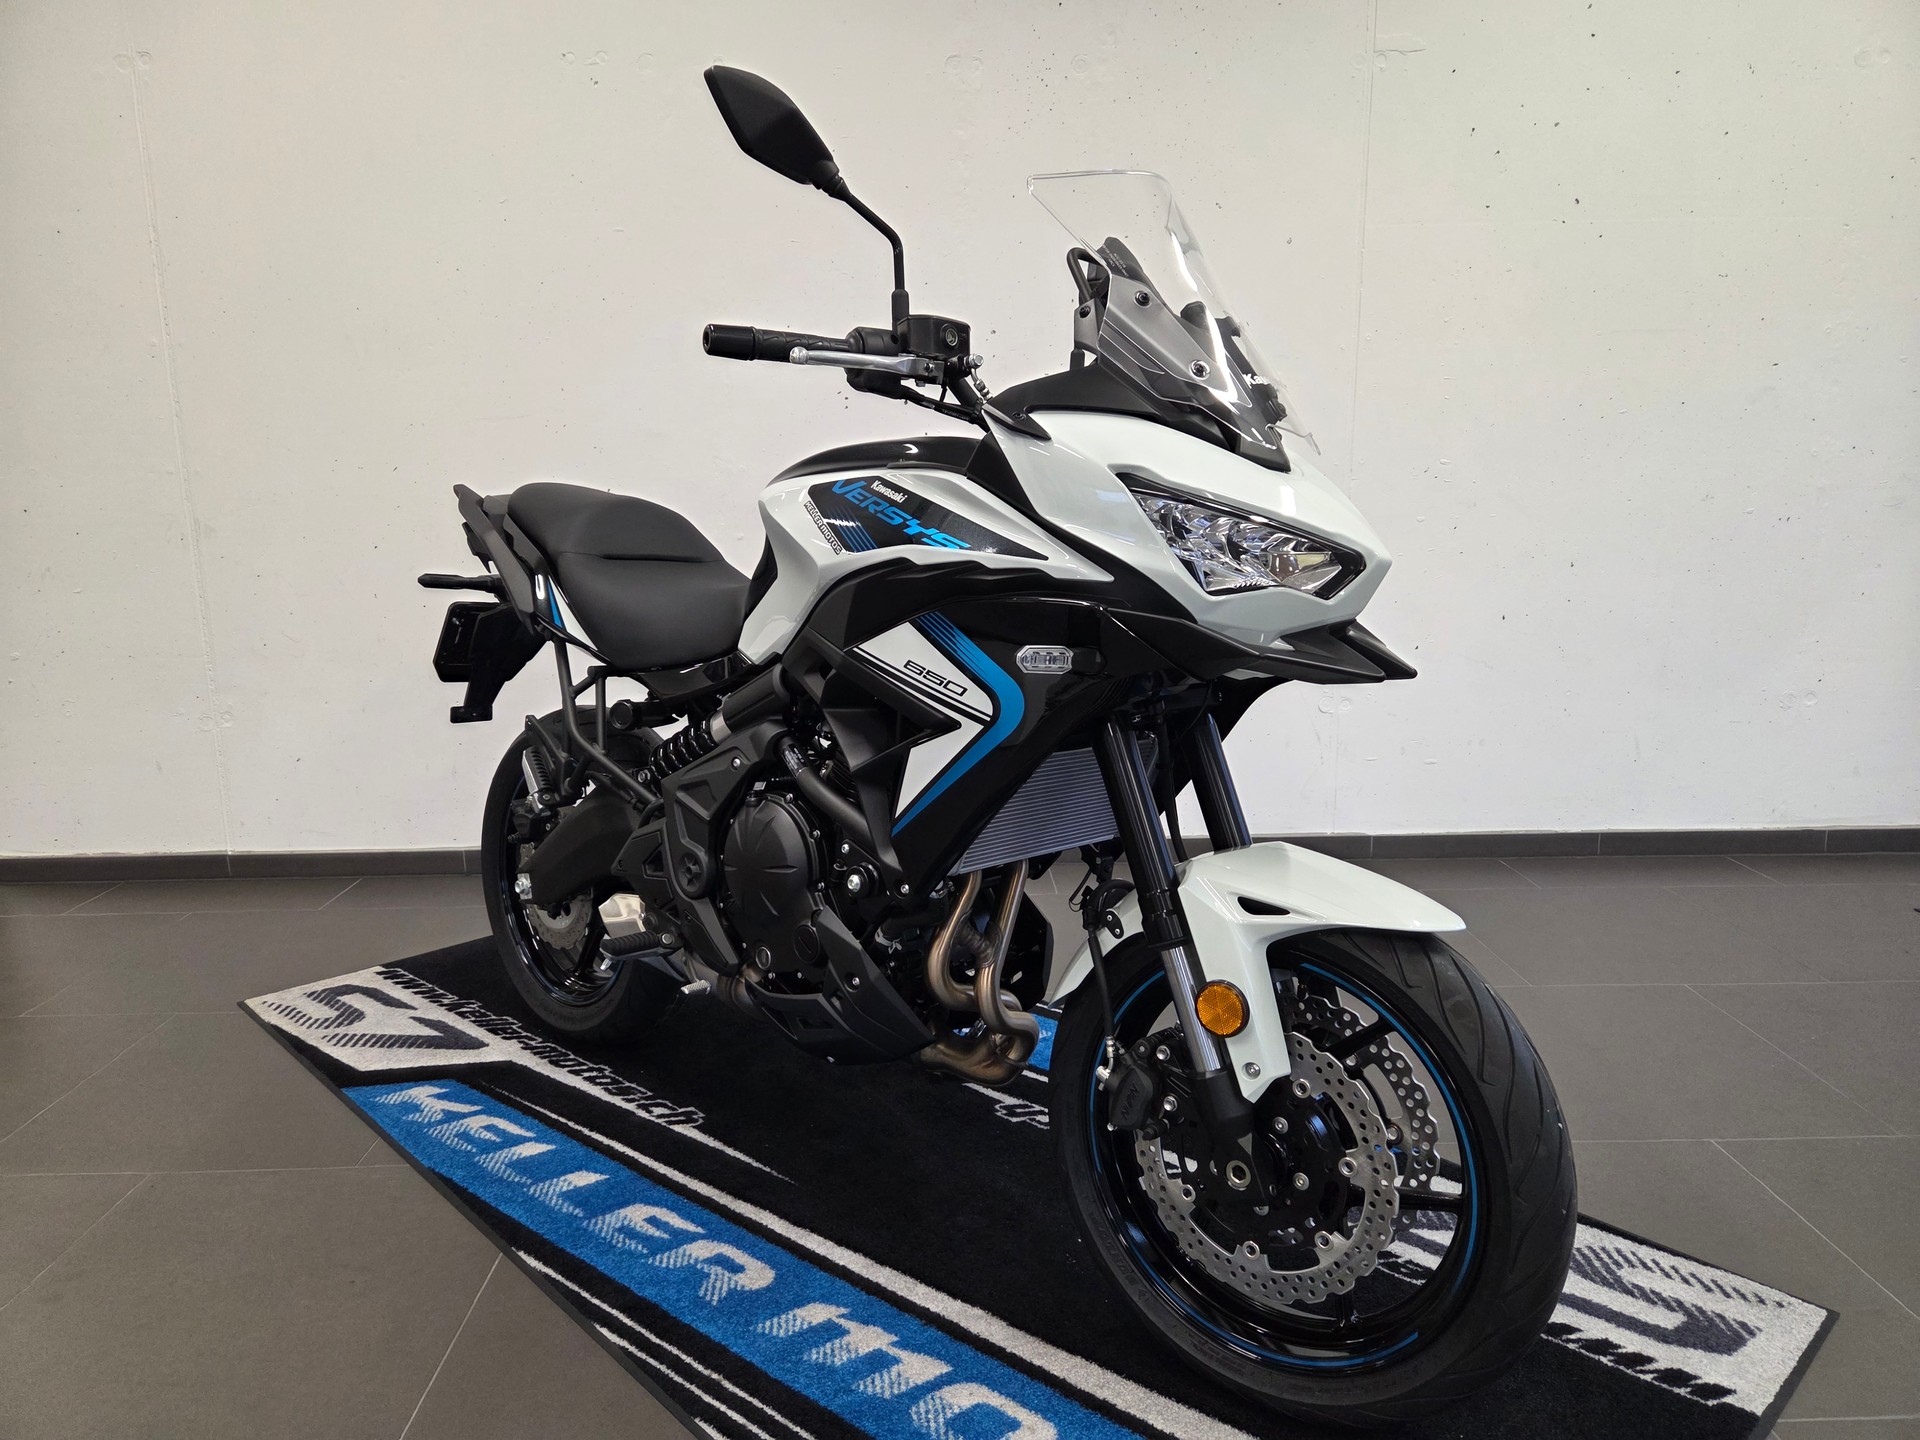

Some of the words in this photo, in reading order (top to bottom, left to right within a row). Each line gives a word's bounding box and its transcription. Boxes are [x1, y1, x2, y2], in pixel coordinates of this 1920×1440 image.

[831, 479, 972, 550] VERSYS
[870, 479, 908, 504] Kawasaki
[903, 659, 968, 697] 650
[373, 1084, 777, 1308] KELLER
